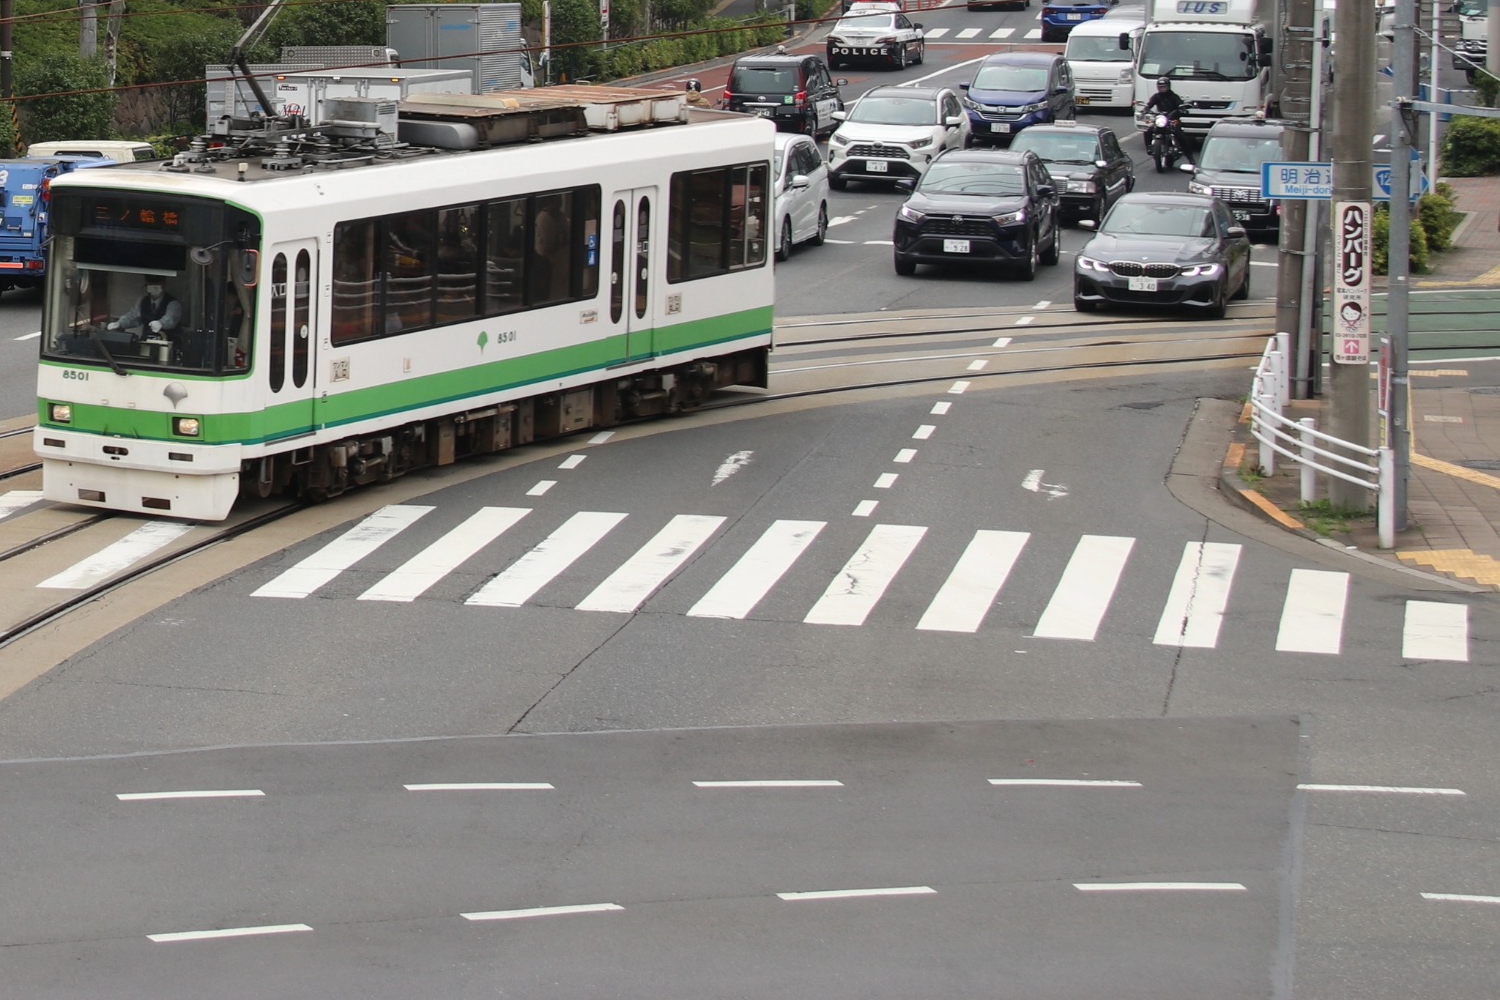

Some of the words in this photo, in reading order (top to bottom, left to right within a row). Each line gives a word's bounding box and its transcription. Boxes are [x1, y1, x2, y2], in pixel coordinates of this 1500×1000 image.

[831, 47, 889, 56] POLICE
[1343, 209, 1363, 283] ハンバーグ
[497, 330, 517, 345] 8501
[62, 369, 90, 382] 8501
